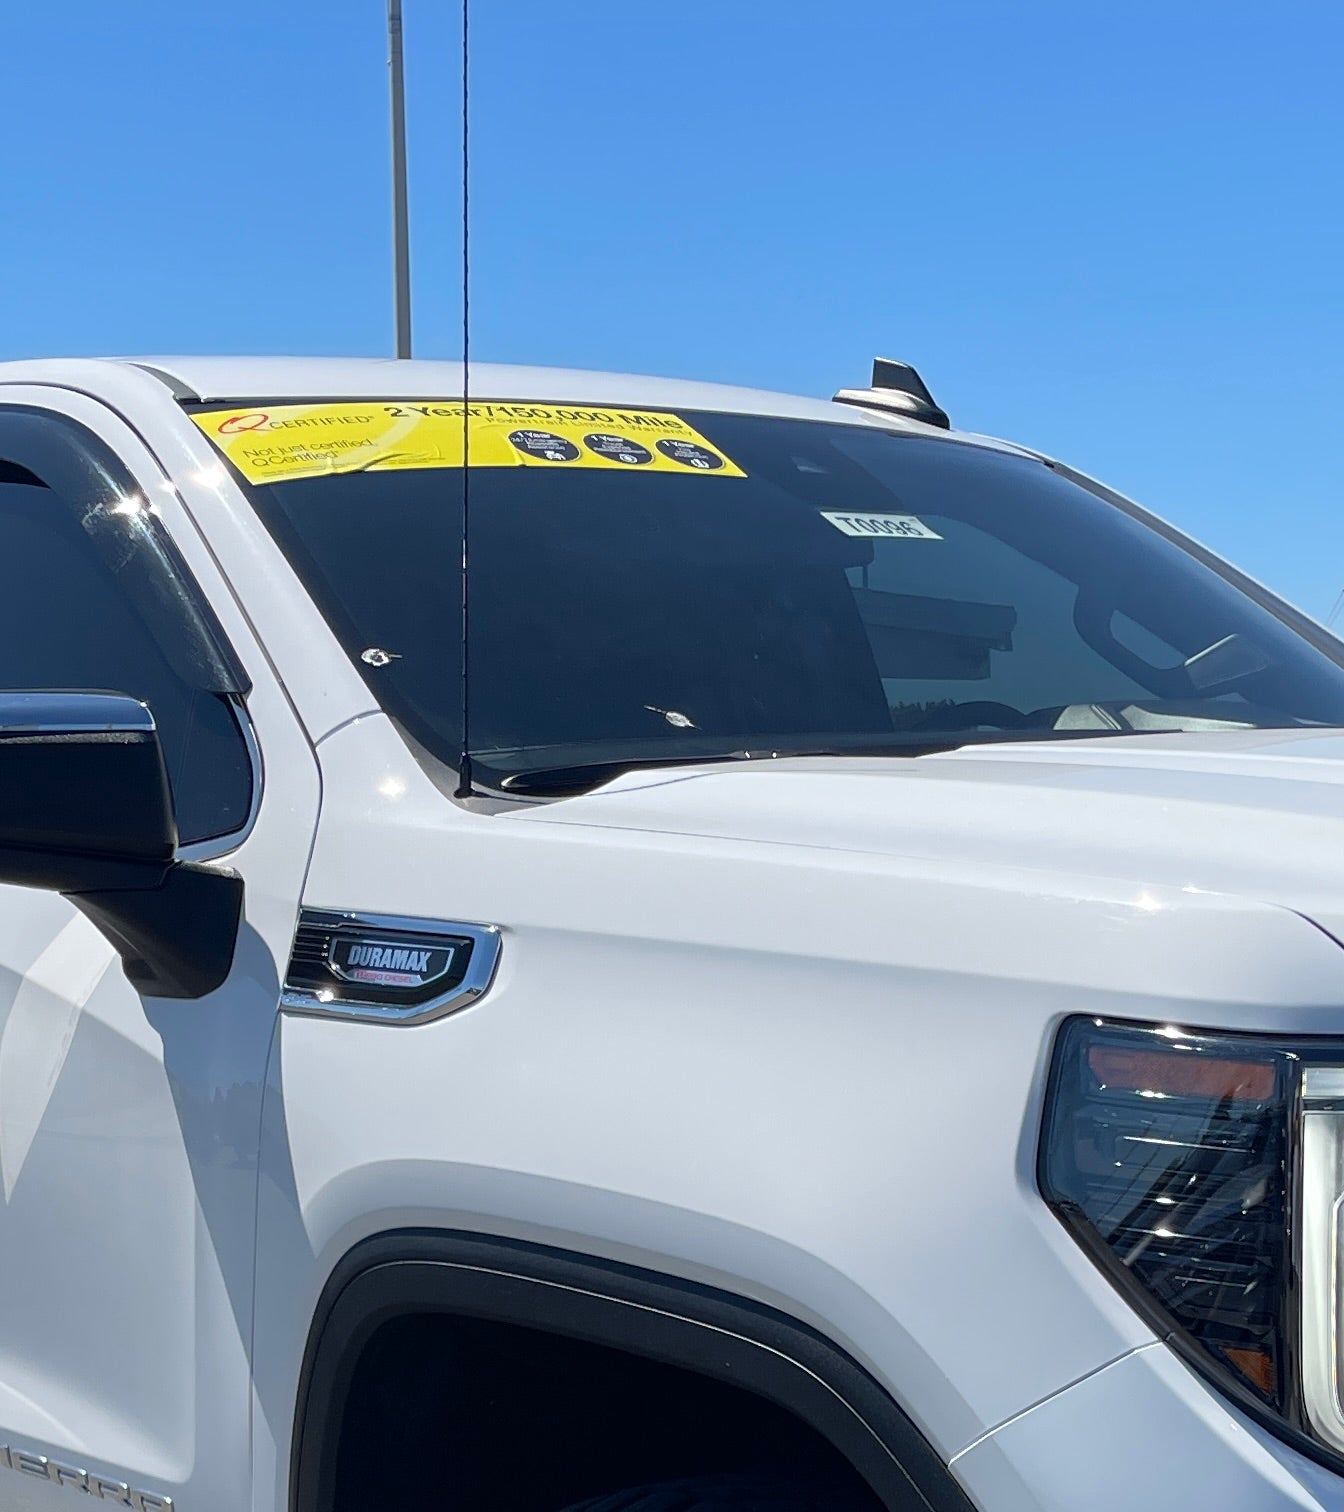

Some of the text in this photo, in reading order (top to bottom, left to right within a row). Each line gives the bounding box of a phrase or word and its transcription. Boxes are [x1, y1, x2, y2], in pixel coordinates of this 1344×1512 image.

[384, 406, 406, 418] 2
[623, 415, 683, 429] Mile
[243, 447, 276, 458] Not
[277, 443, 307, 459] just
[834, 516, 924, 536] T0096
[347, 945, 432, 973] DURAMAX
